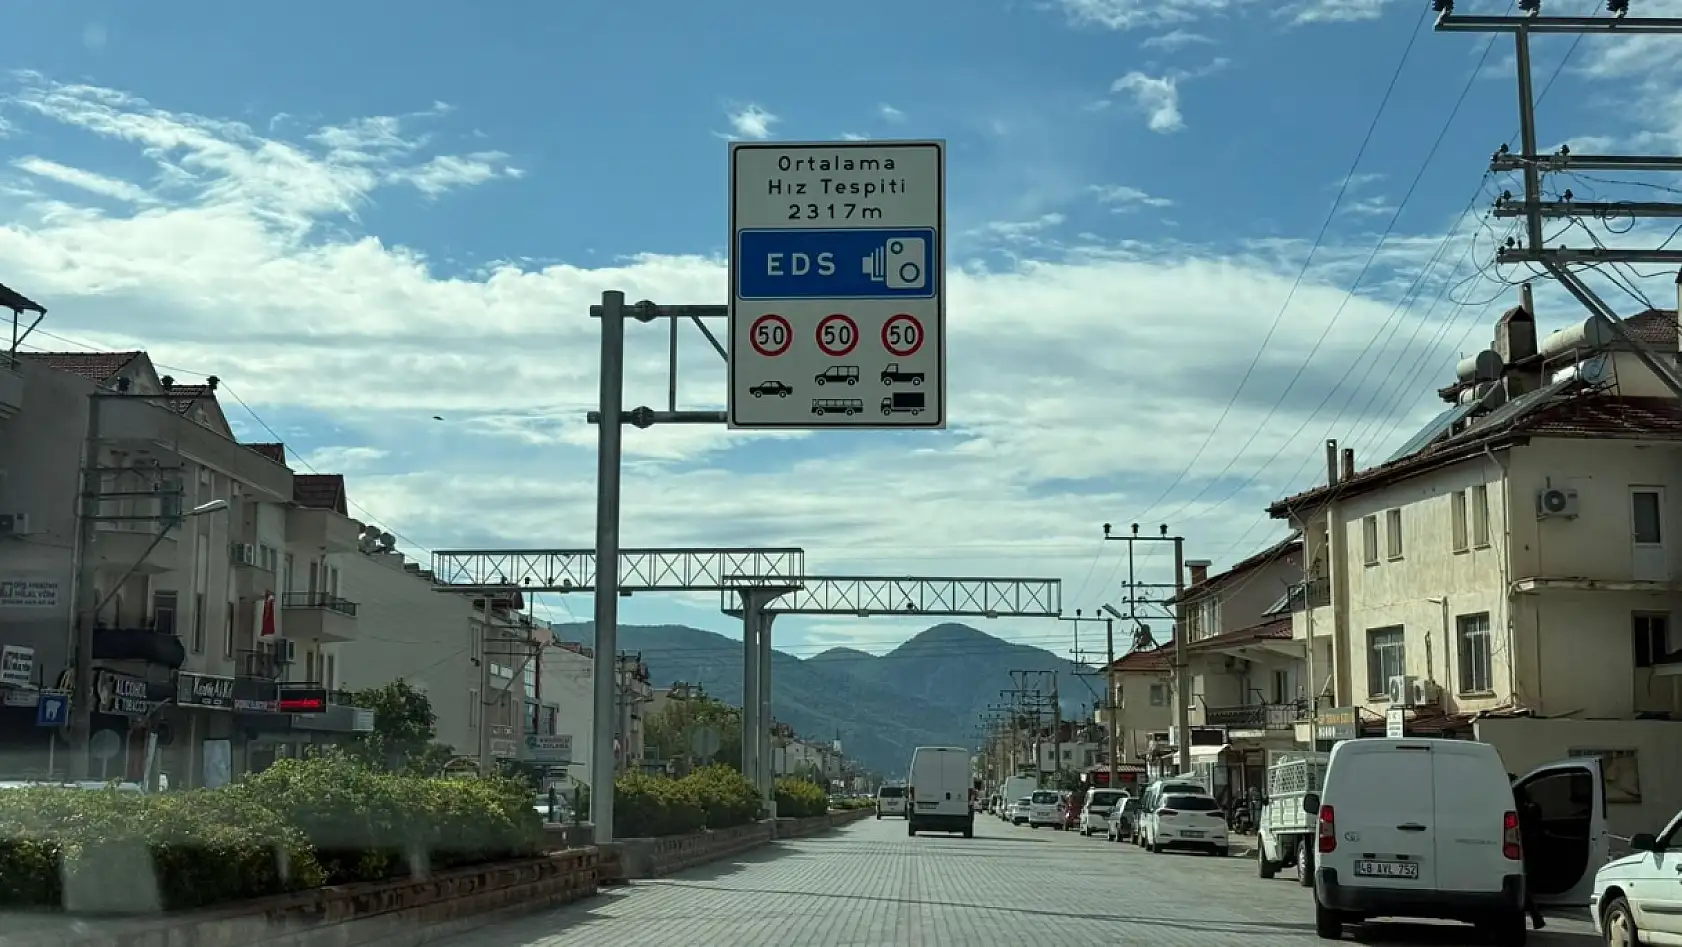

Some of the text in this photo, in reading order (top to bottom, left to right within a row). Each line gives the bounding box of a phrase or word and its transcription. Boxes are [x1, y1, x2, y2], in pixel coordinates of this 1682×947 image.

[778, 156, 895, 171] Ortalama
[768, 179, 906, 198] Hız Tespiti
[788, 204, 882, 219] 2317m
[767, 252, 836, 276] EDS
[758, 326, 785, 345] 50
[824, 326, 851, 345] 50
[890, 326, 916, 345] 50
